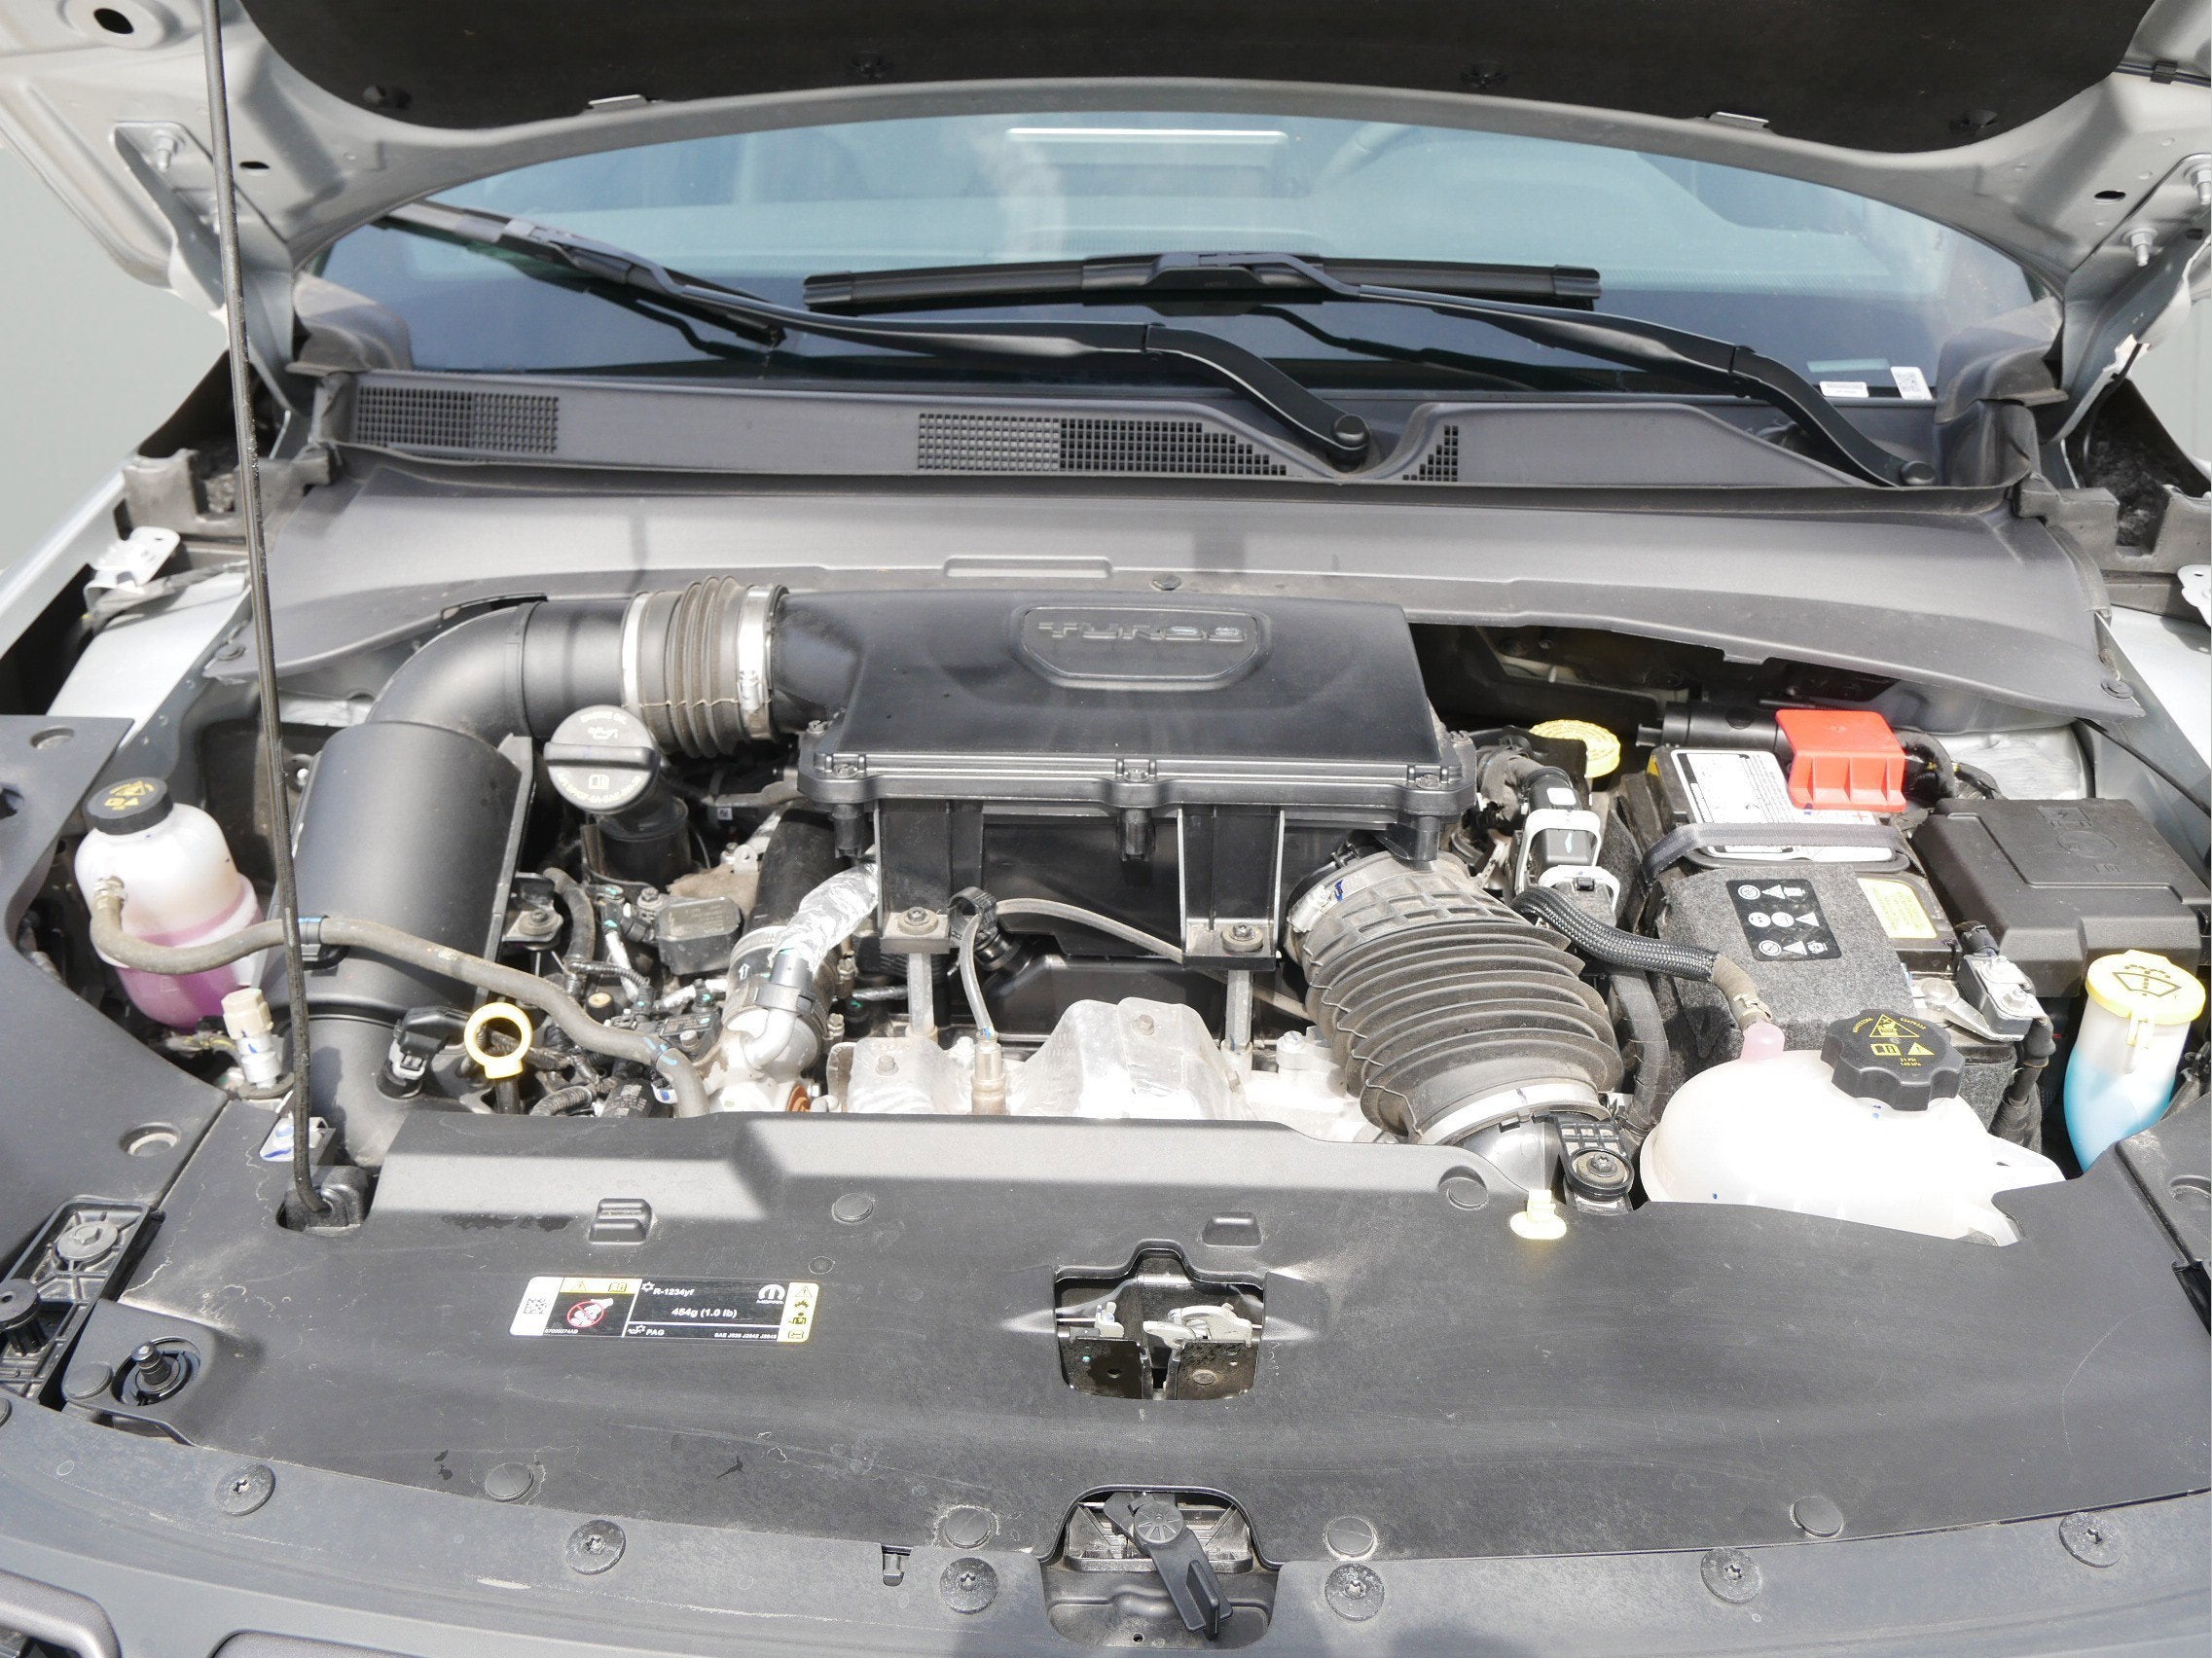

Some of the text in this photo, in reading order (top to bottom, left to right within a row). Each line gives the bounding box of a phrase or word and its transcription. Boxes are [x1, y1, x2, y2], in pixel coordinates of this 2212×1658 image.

[1038, 622, 1247, 642] TURBO
[652, 1287, 695, 1298] R-1234yf
[700, 1308, 721, 1318] (1.0
[722, 1308, 738, 1319] lb)
[646, 1328, 666, 1337] PAG
